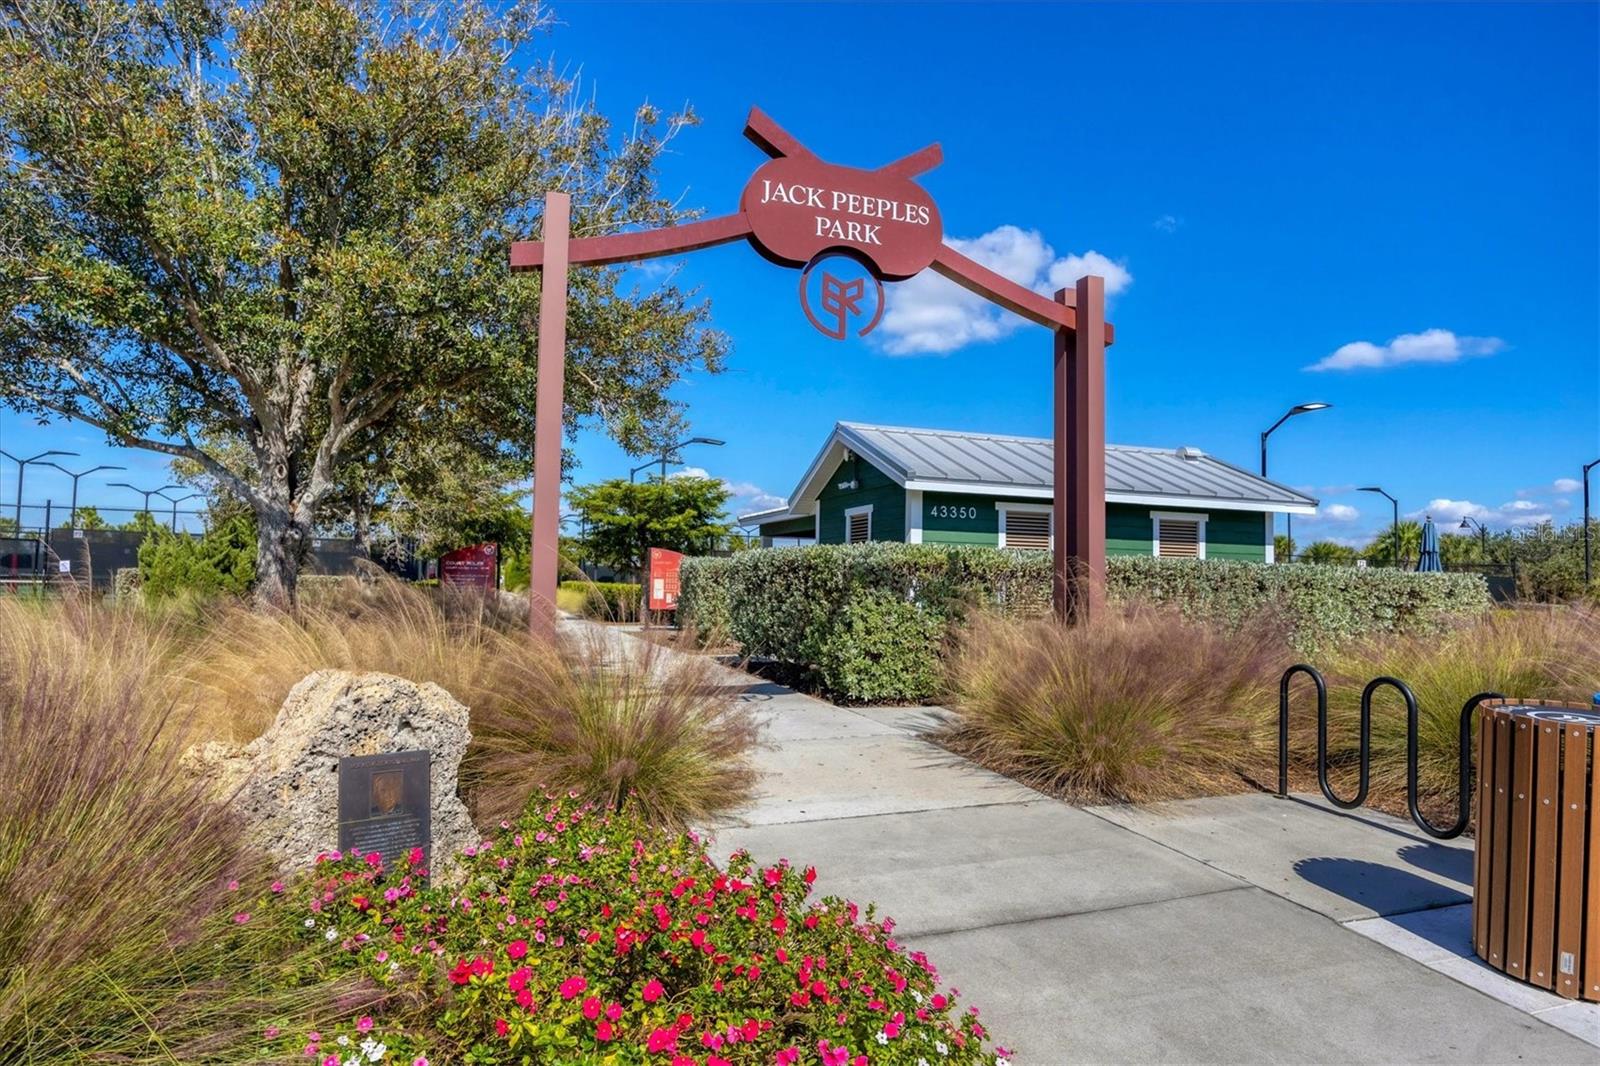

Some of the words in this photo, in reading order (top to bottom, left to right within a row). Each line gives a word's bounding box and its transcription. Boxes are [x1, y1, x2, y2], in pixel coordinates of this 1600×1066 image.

[761, 180, 825, 208] JACK
[832, 191, 930, 226] PEEPLES
[815, 216, 882, 245] PARK
[930, 505, 977, 519] 43350
